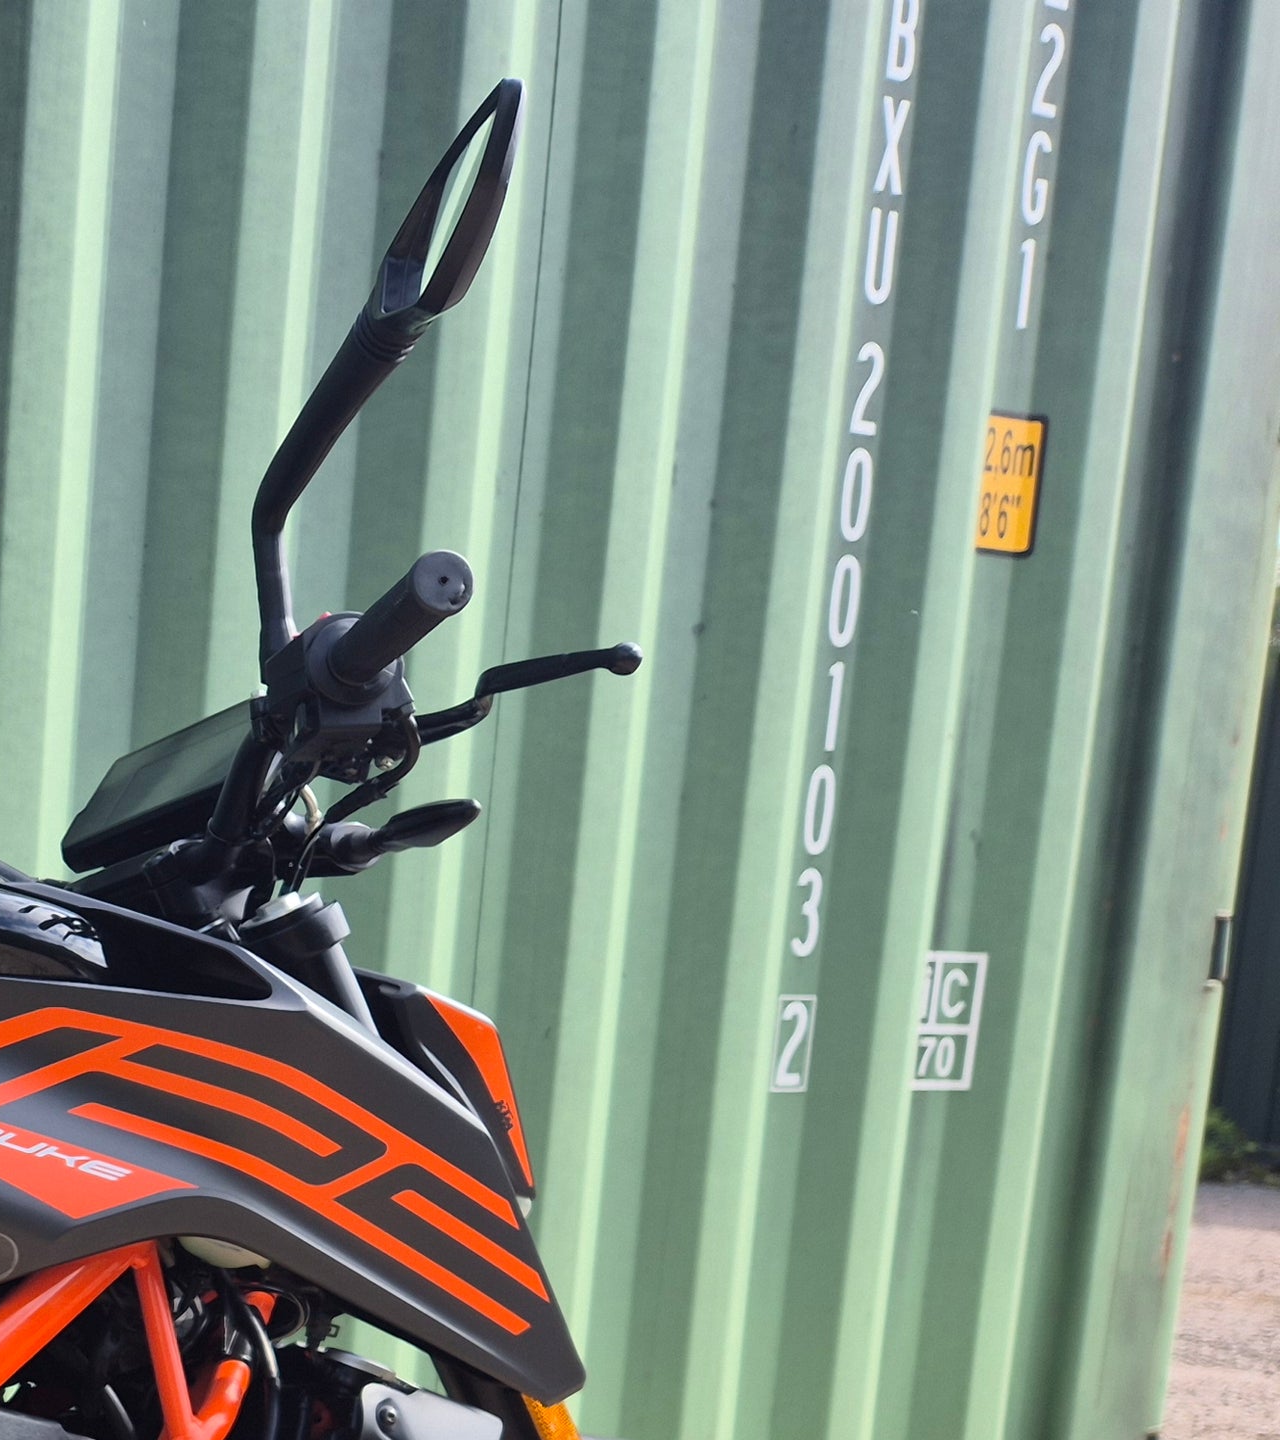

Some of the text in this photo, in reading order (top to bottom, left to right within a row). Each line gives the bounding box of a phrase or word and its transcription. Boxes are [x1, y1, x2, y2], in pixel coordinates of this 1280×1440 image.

[1016, 0, 1070, 331] 2G1
[790, 341, 885, 958] 200103
[773, 1000, 808, 1088] 2
